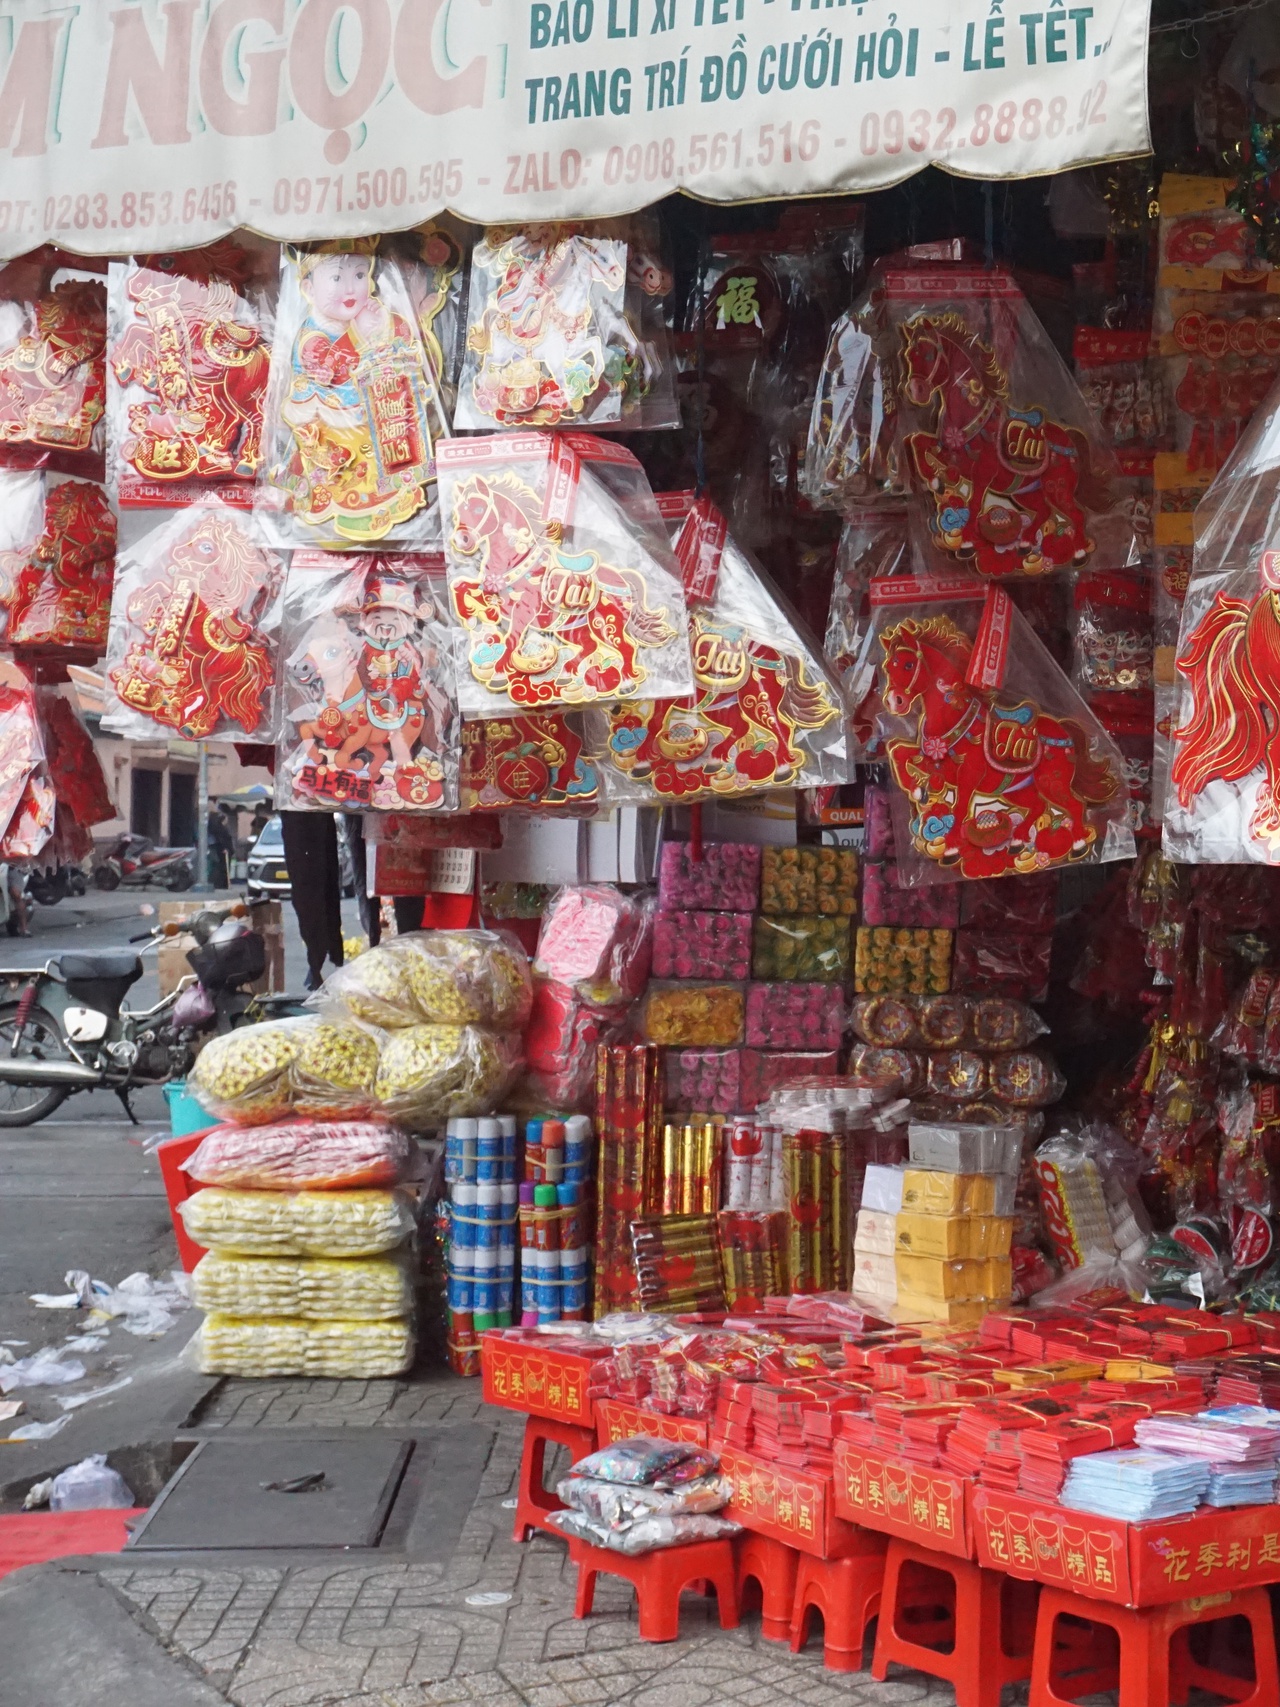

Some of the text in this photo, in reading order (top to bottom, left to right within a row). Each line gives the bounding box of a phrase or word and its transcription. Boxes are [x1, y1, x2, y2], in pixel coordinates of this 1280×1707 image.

[90, 0, 488, 166] NGỌC
[525, 67, 632, 124] TRANG
[644, 45, 692, 111] TRÍ
[700, 33, 748, 103] ĐỒ
[757, 27, 844, 95] CƯỚI
[854, 12, 919, 84] HỎI
[43, 180, 237, 232] 0283.853.6456
[273, 158, 464, 216] 0971.500.595
[503, 148, 592, 195] ZALO:
[603, 120, 821, 186] 0908.561.516
[860, 79, 1107, 156] 0932.8888.92
[716, 276, 761, 324] 福
[1006, 419, 1046, 460] Tài
[995, 720, 1039, 761] Tài
[299, 765, 373, 802] 马上有福
[847, 1475, 884, 1509] 花季
[913, 1497, 951, 1531] 精品
[989, 1529, 1033, 1565] 花季
[1067, 1551, 1112, 1584] 精品
